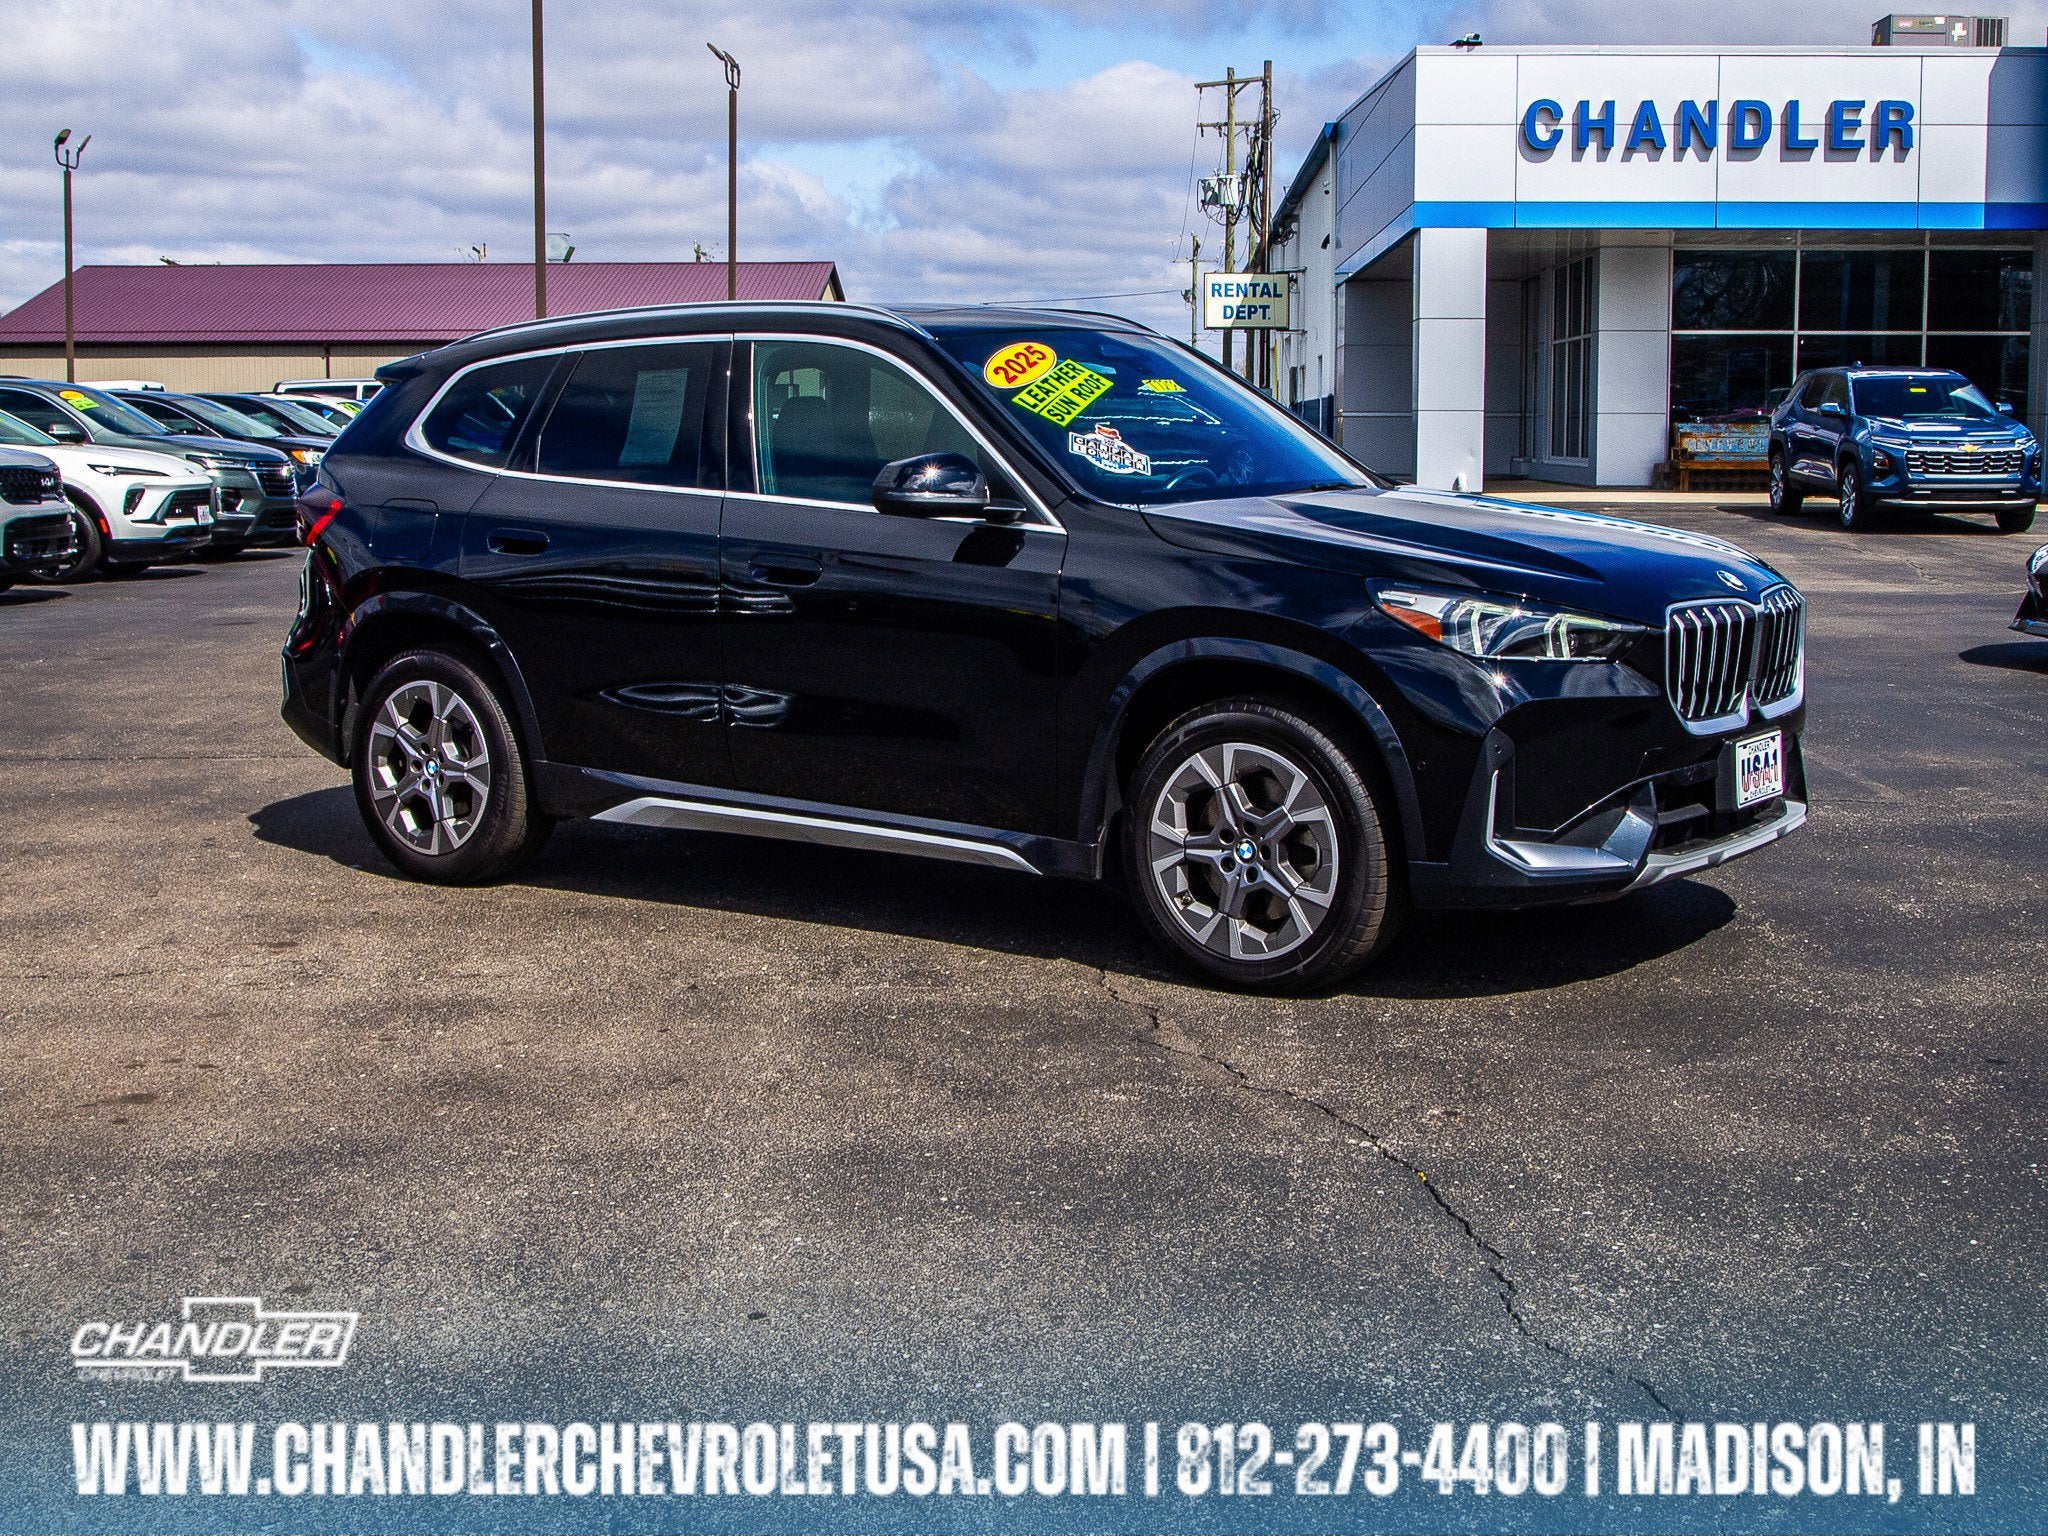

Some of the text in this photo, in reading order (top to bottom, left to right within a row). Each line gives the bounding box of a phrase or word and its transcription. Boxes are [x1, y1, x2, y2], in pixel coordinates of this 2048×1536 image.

[1522, 98, 1917, 149] CHANDLER
[1211, 282, 1283, 298] RENTAL
[1223, 304, 1271, 320] DEPT.
[993, 345, 1047, 384] 2025
[1018, 362, 1085, 409] LEATHER
[1047, 373, 1107, 423] SUN ROOF
